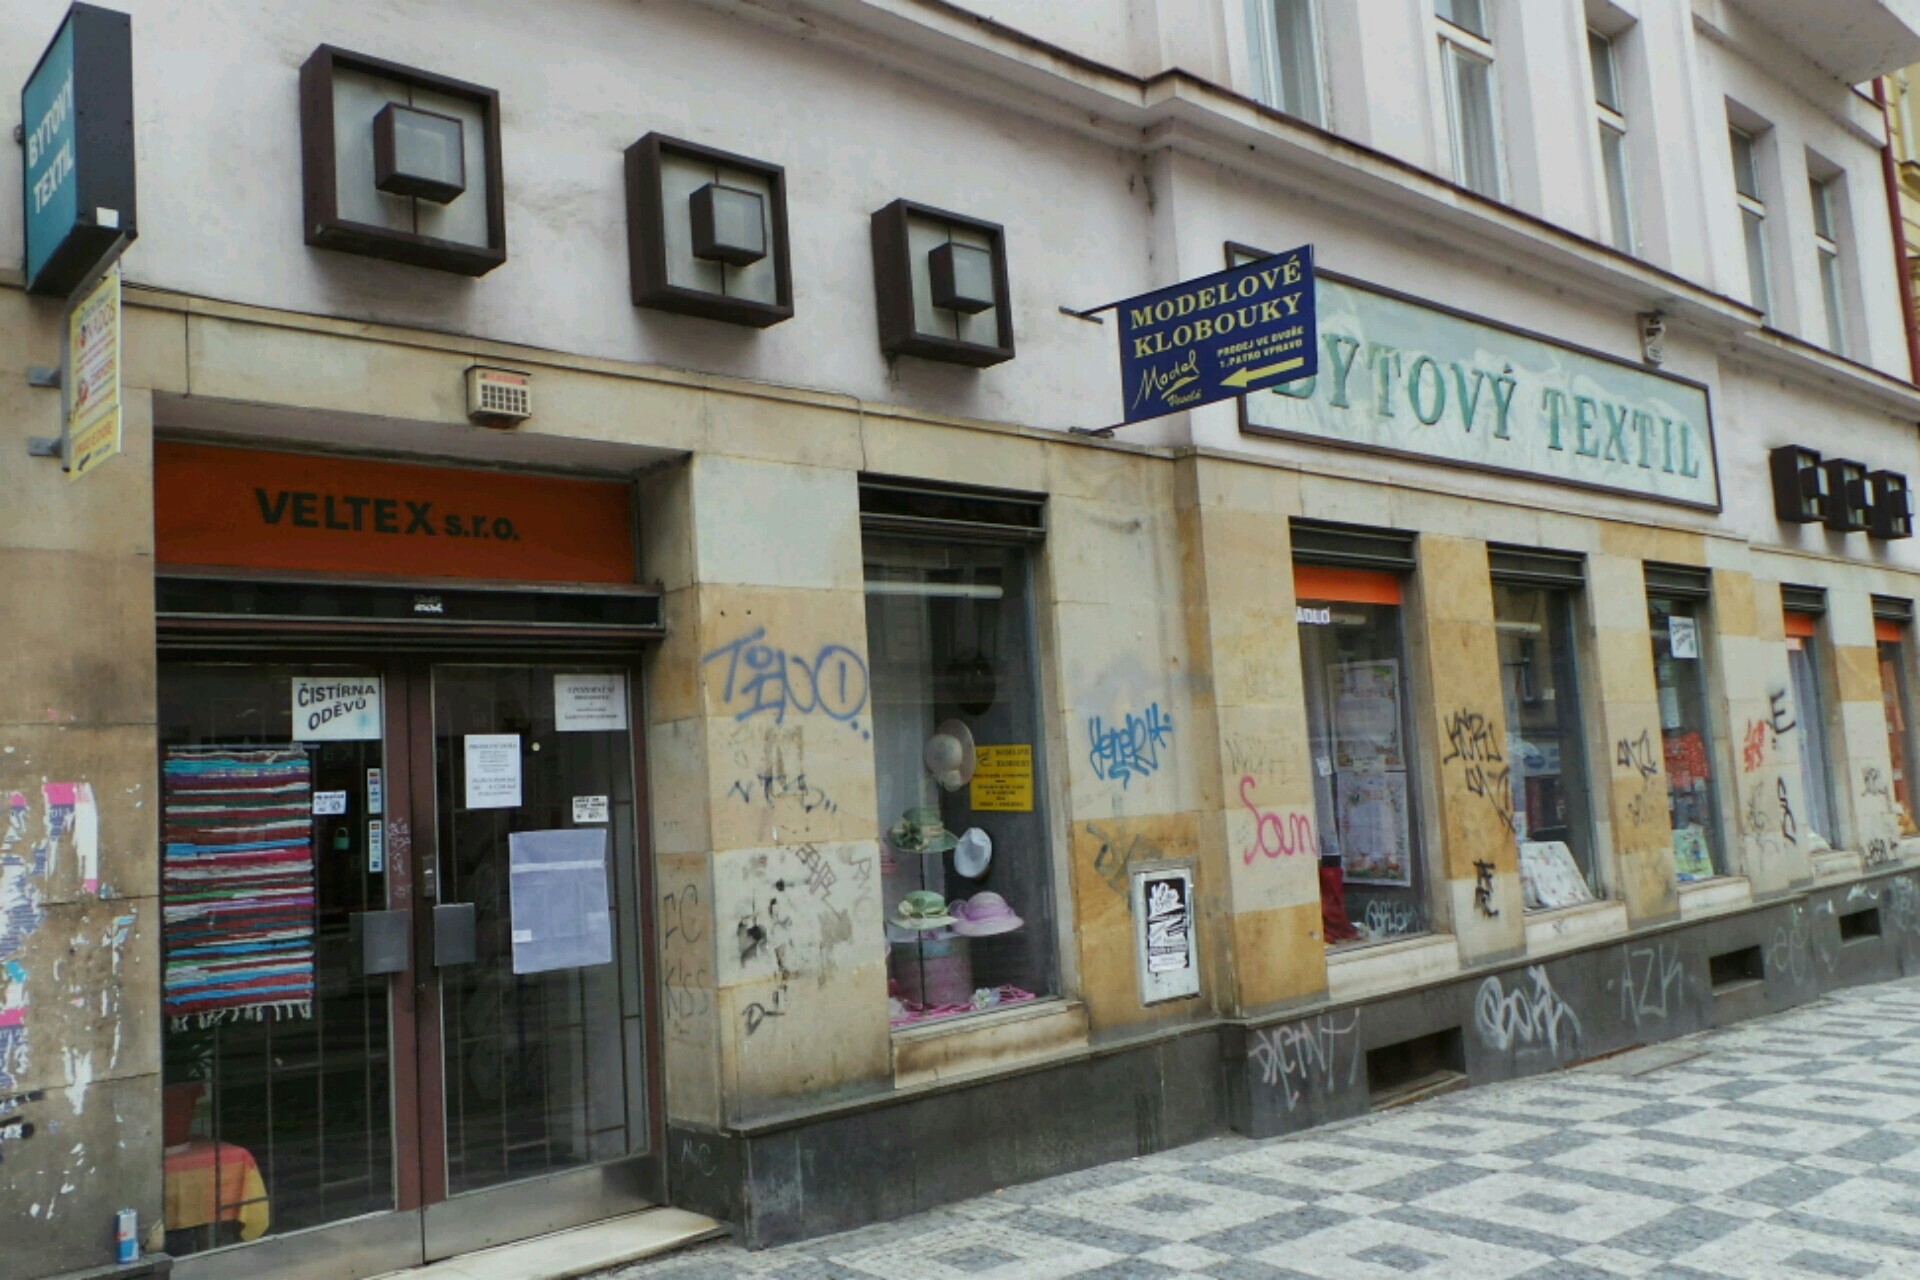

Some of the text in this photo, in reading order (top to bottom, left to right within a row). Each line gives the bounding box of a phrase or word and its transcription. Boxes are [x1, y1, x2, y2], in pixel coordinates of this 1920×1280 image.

[33, 139, 74, 214] TEXTIL
[1129, 254, 1302, 331] MODELOVÉ
[1133, 292, 1303, 359] KLOBOUKY
[1255, 335, 1270, 347] VE
[1262, 338, 1303, 356] VPRAVO
[1131, 348, 1200, 411] Model
[1542, 386, 1700, 479] TEXTIL
[255, 487, 521, 542] VELTEX s.r.o.
[297, 682, 377, 708] ČISTÍRNA
[307, 697, 367, 731] ODĚVŮ
